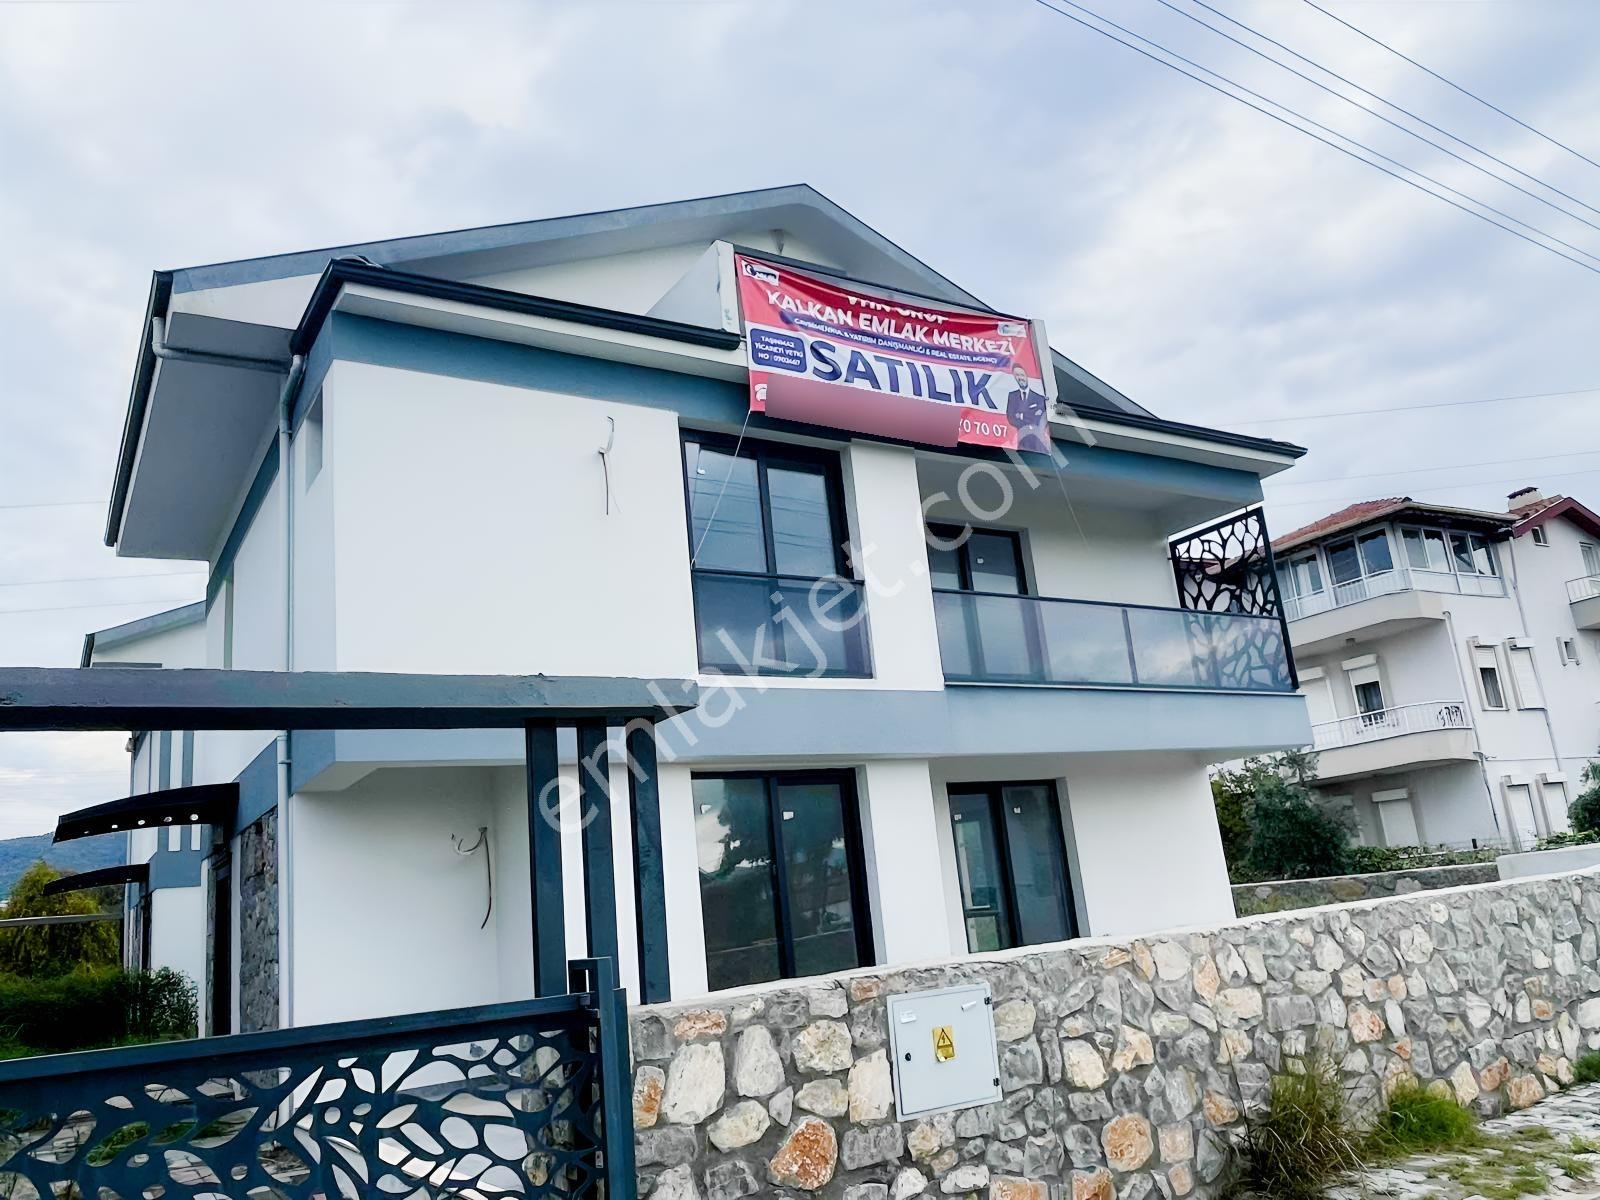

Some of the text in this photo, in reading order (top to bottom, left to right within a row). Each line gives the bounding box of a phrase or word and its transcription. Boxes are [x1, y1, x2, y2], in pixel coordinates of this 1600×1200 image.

[766, 289, 853, 326] KALKAN
[859, 312, 930, 344] EMLAK
[932, 329, 1015, 355] MERKEZİ
[810, 340, 998, 410] SATILIK
[973, 421, 990, 436] 70
[992, 424, 1008, 438] 07
